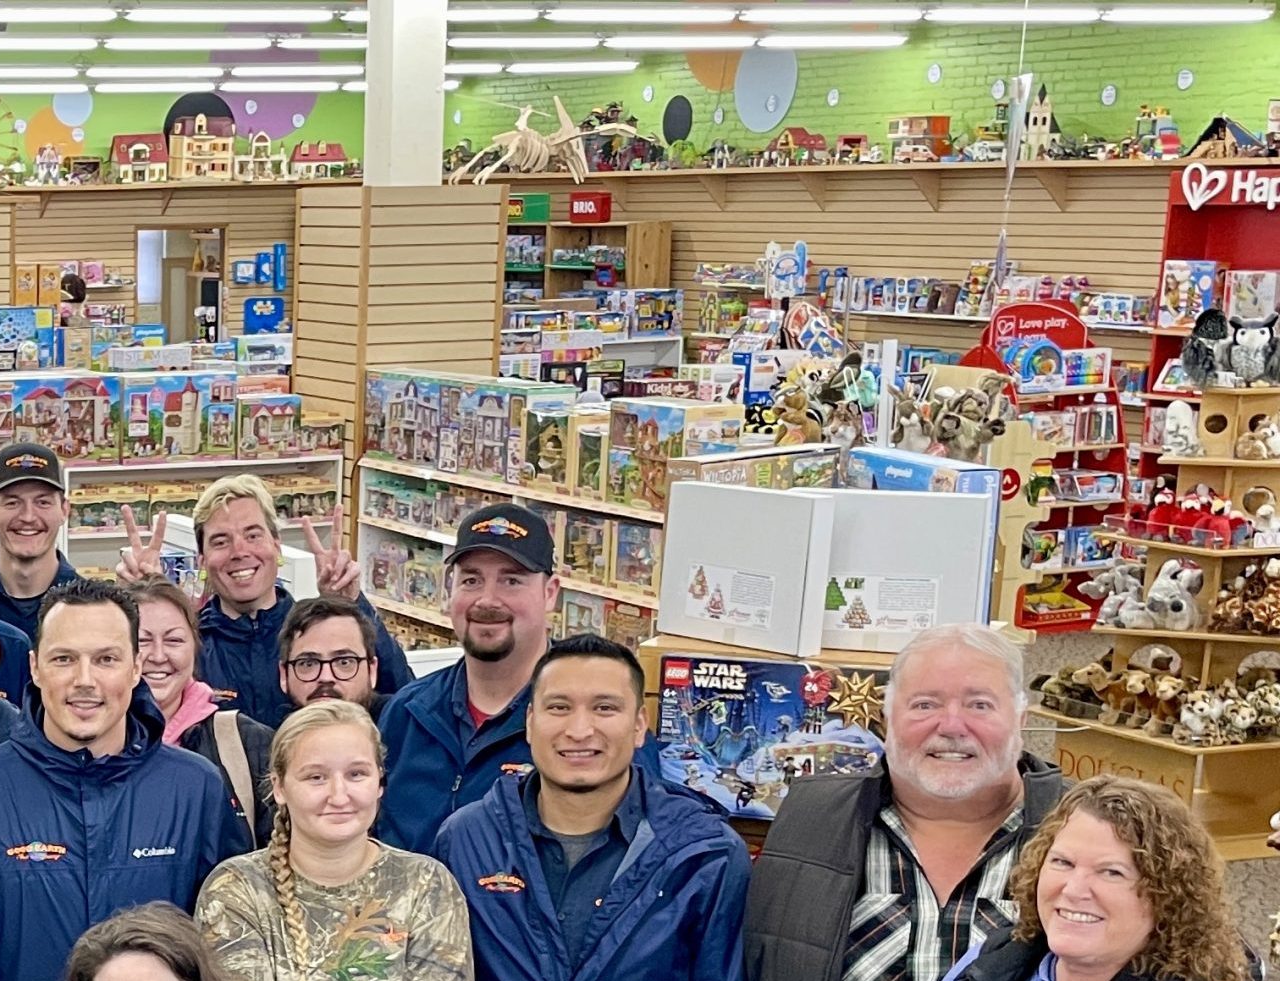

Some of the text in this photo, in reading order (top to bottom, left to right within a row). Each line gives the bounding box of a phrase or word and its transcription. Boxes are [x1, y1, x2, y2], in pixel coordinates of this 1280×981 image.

[1019, 318, 1043, 329] Love
[665, 662, 747, 679] LEGO STAR
[694, 675, 747, 690] WARS
[805, 681, 818, 692] 24
[663, 688, 677, 697] 6+
[142, 846, 176, 857] Columbia
